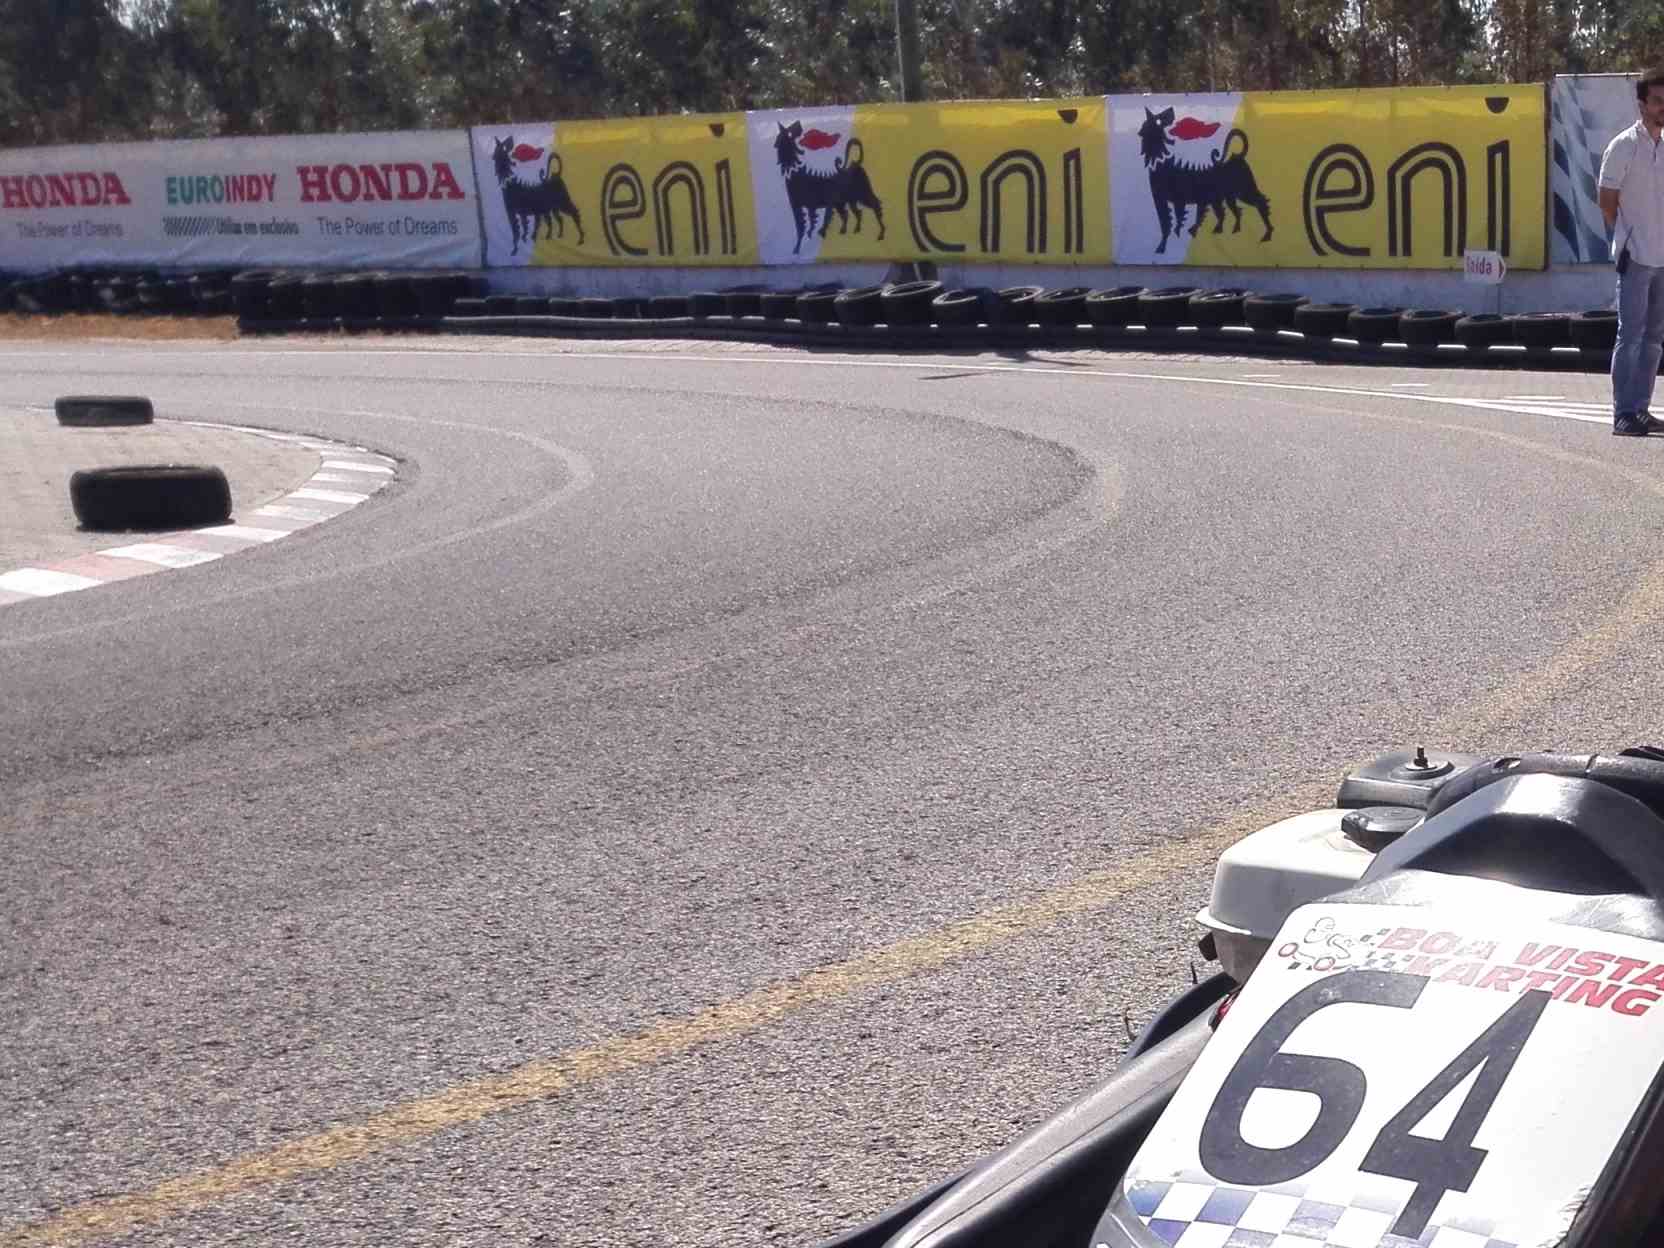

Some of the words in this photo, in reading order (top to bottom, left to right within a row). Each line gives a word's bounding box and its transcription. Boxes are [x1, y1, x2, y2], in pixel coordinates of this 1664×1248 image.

[0, 171, 131, 208] HONDA
[166, 173, 276, 205] EUROINDY
[296, 162, 465, 202] HONDA
[601, 124, 736, 255] eni
[908, 109, 1083, 253] eni
[1303, 97, 1510, 257] eni
[316, 217, 342, 235] The
[345, 216, 385, 236] Power
[388, 216, 403, 235] of
[404, 215, 458, 235] Dreams
[1377, 927, 1497, 960] BOA
[1403, 954, 1662, 1017] KARTING
[1198, 970, 1553, 1240] 64
